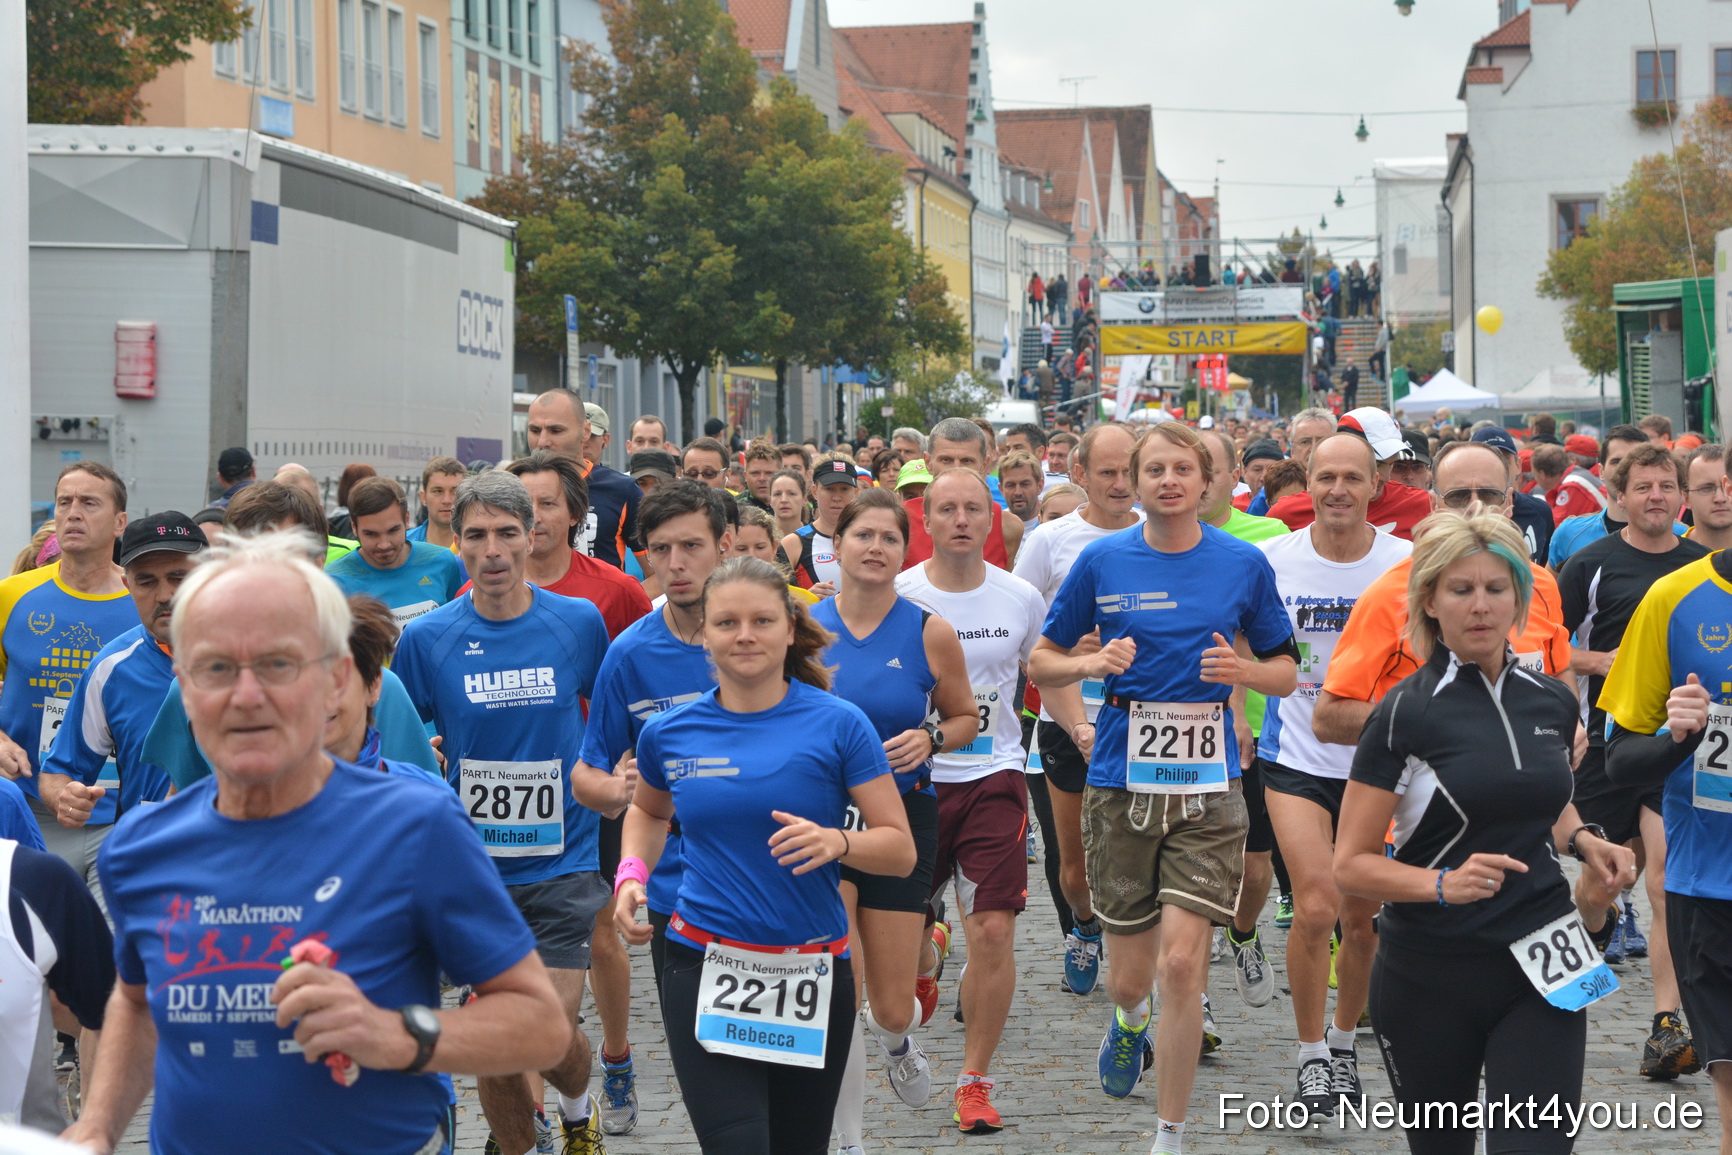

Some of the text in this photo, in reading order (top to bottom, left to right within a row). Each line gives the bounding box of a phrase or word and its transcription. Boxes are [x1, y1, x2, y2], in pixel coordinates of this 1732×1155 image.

[458, 289, 503, 360] BOCK
[1168, 329, 1239, 348] START
[1295, 595, 1335, 606] Amberger
[396, 608, 429, 621] Neumarkt
[957, 627, 1009, 640] hasit.de
[464, 666, 556, 693] HUBER
[485, 687, 552, 700] TECHNOLOGY
[530, 698, 554, 706] Solutions
[46, 705, 66, 716] PAR
[1131, 710, 1209, 721] PARTL Neumarkt
[1138, 724, 1216, 759] 2218
[1707, 730, 1729, 770] 2
[462, 768, 547, 780] PARTL Neumarkt
[1155, 767, 1199, 784] Philipp
[469, 784, 555, 820] 2870
[484, 829, 538, 843] Michael
[1527, 919, 1594, 986] 287
[707, 953, 809, 975] PARTL Neumarkt
[167, 983, 210, 1011] DU
[712, 973, 819, 1021] 2219
[215, 1012, 223, 1023] 7
[726, 1022, 795, 1048] Rebecca
